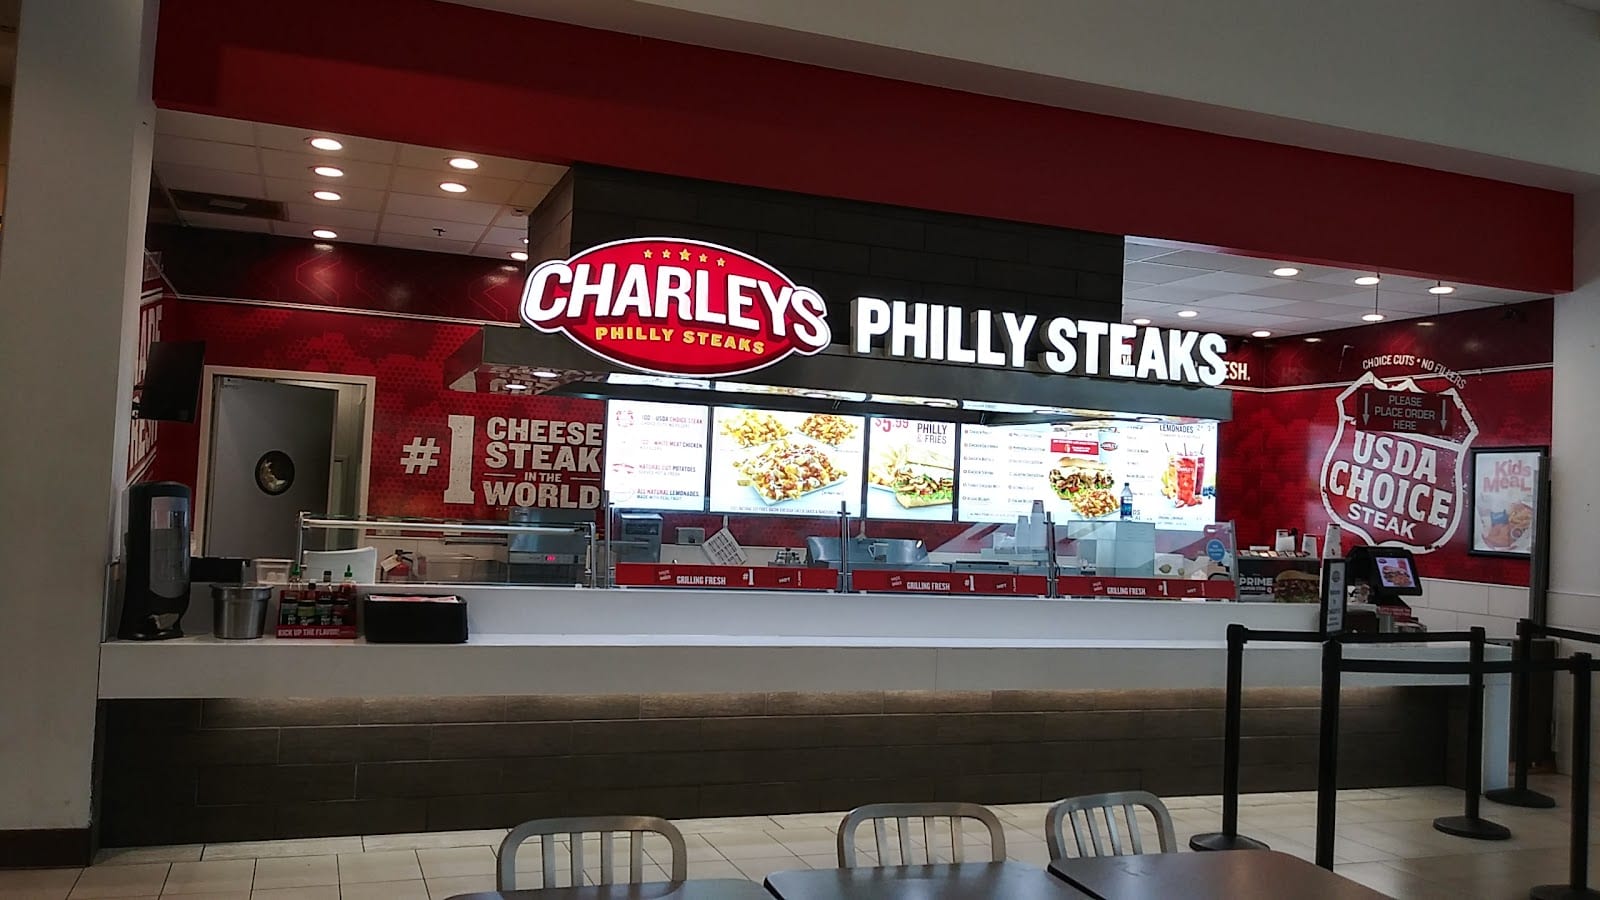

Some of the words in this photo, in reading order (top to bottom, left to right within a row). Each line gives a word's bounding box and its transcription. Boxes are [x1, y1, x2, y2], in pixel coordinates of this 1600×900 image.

[525, 262, 830, 347] CHARLEYS
[595, 326, 674, 342] PHILLY
[683, 330, 765, 354] STEAKS
[853, 296, 1037, 368] PHILLY
[1043, 316, 1228, 387] STEAKS
[1362, 354, 1392, 370] CHOICE
[1393, 354, 1415, 366] CUTS
[1420, 358, 1434, 371] NO
[1434, 363, 1467, 390] FILLERS
[1388, 395, 1423, 407] PLEASE
[1374, 406, 1403, 417] PLACE
[1404, 408, 1436, 420] ORDER
[486, 416, 603, 446] CHEESE
[917, 422, 948, 435] PHILLY
[1159, 424, 1194, 433] LEMONADES
[1392, 419, 1417, 431] HERE
[924, 434, 947, 444] FRIES
[400, 414, 475, 504] #1
[484, 442, 601, 473] STEAK
[1352, 430, 1438, 484] USDA
[1494, 458, 1532, 477] Kids
[524, 472, 537, 482] IN
[538, 472, 563, 483] THE
[482, 480, 601, 510] WORLD
[1329, 460, 1453, 529] CHOICE
[1347, 502, 1417, 540] STEAK
[676, 575, 704, 585] GRILLING
[704, 576, 727, 586] FRESH
[906, 581, 931, 590] GRILLING
[931, 582, 951, 591] FRESH
[1239, 577, 1273, 586] PRIME
[1129, 587, 1146, 596] FRESH
[278, 629, 294, 637] KICK
